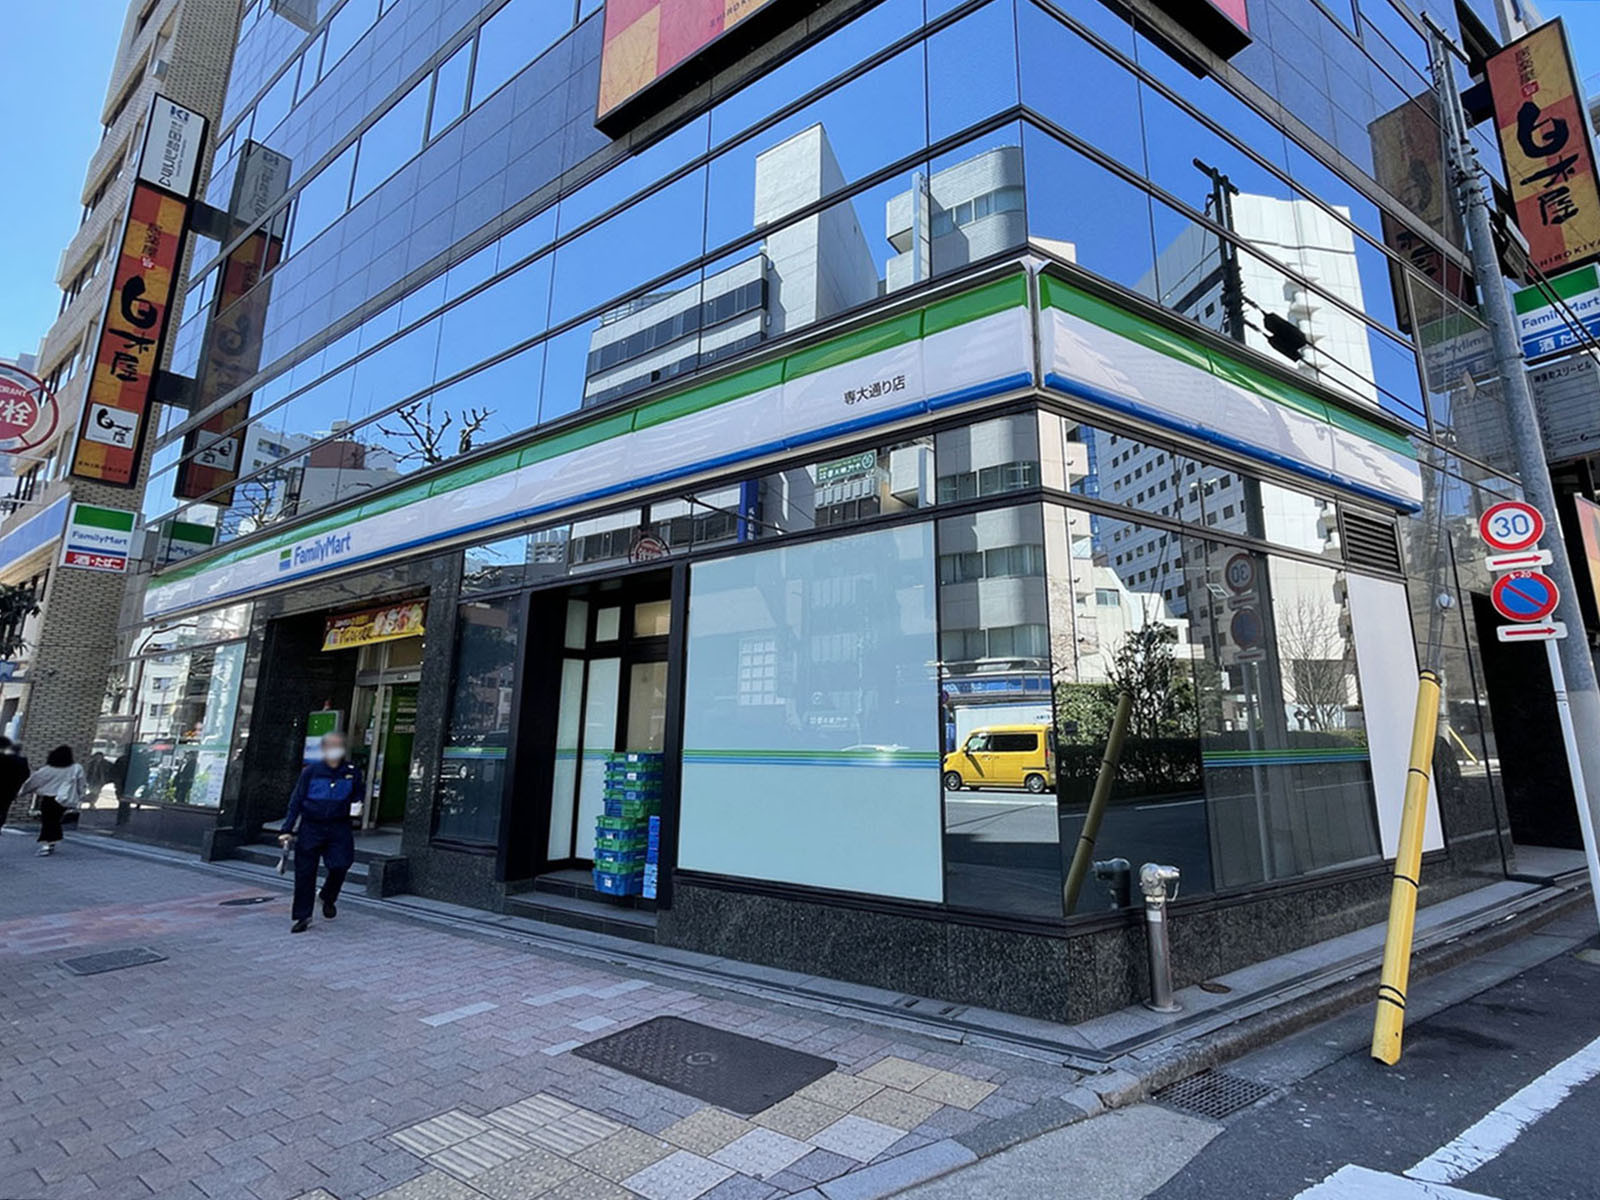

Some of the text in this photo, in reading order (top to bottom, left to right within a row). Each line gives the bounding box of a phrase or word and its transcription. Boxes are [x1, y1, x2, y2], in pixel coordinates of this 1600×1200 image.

[844, 375, 906, 405] 専大通り店
[72, 530, 128, 545] FamilyMart
[1494, 514, 1529, 537] 30
[294, 532, 351, 567] FamilyMart
